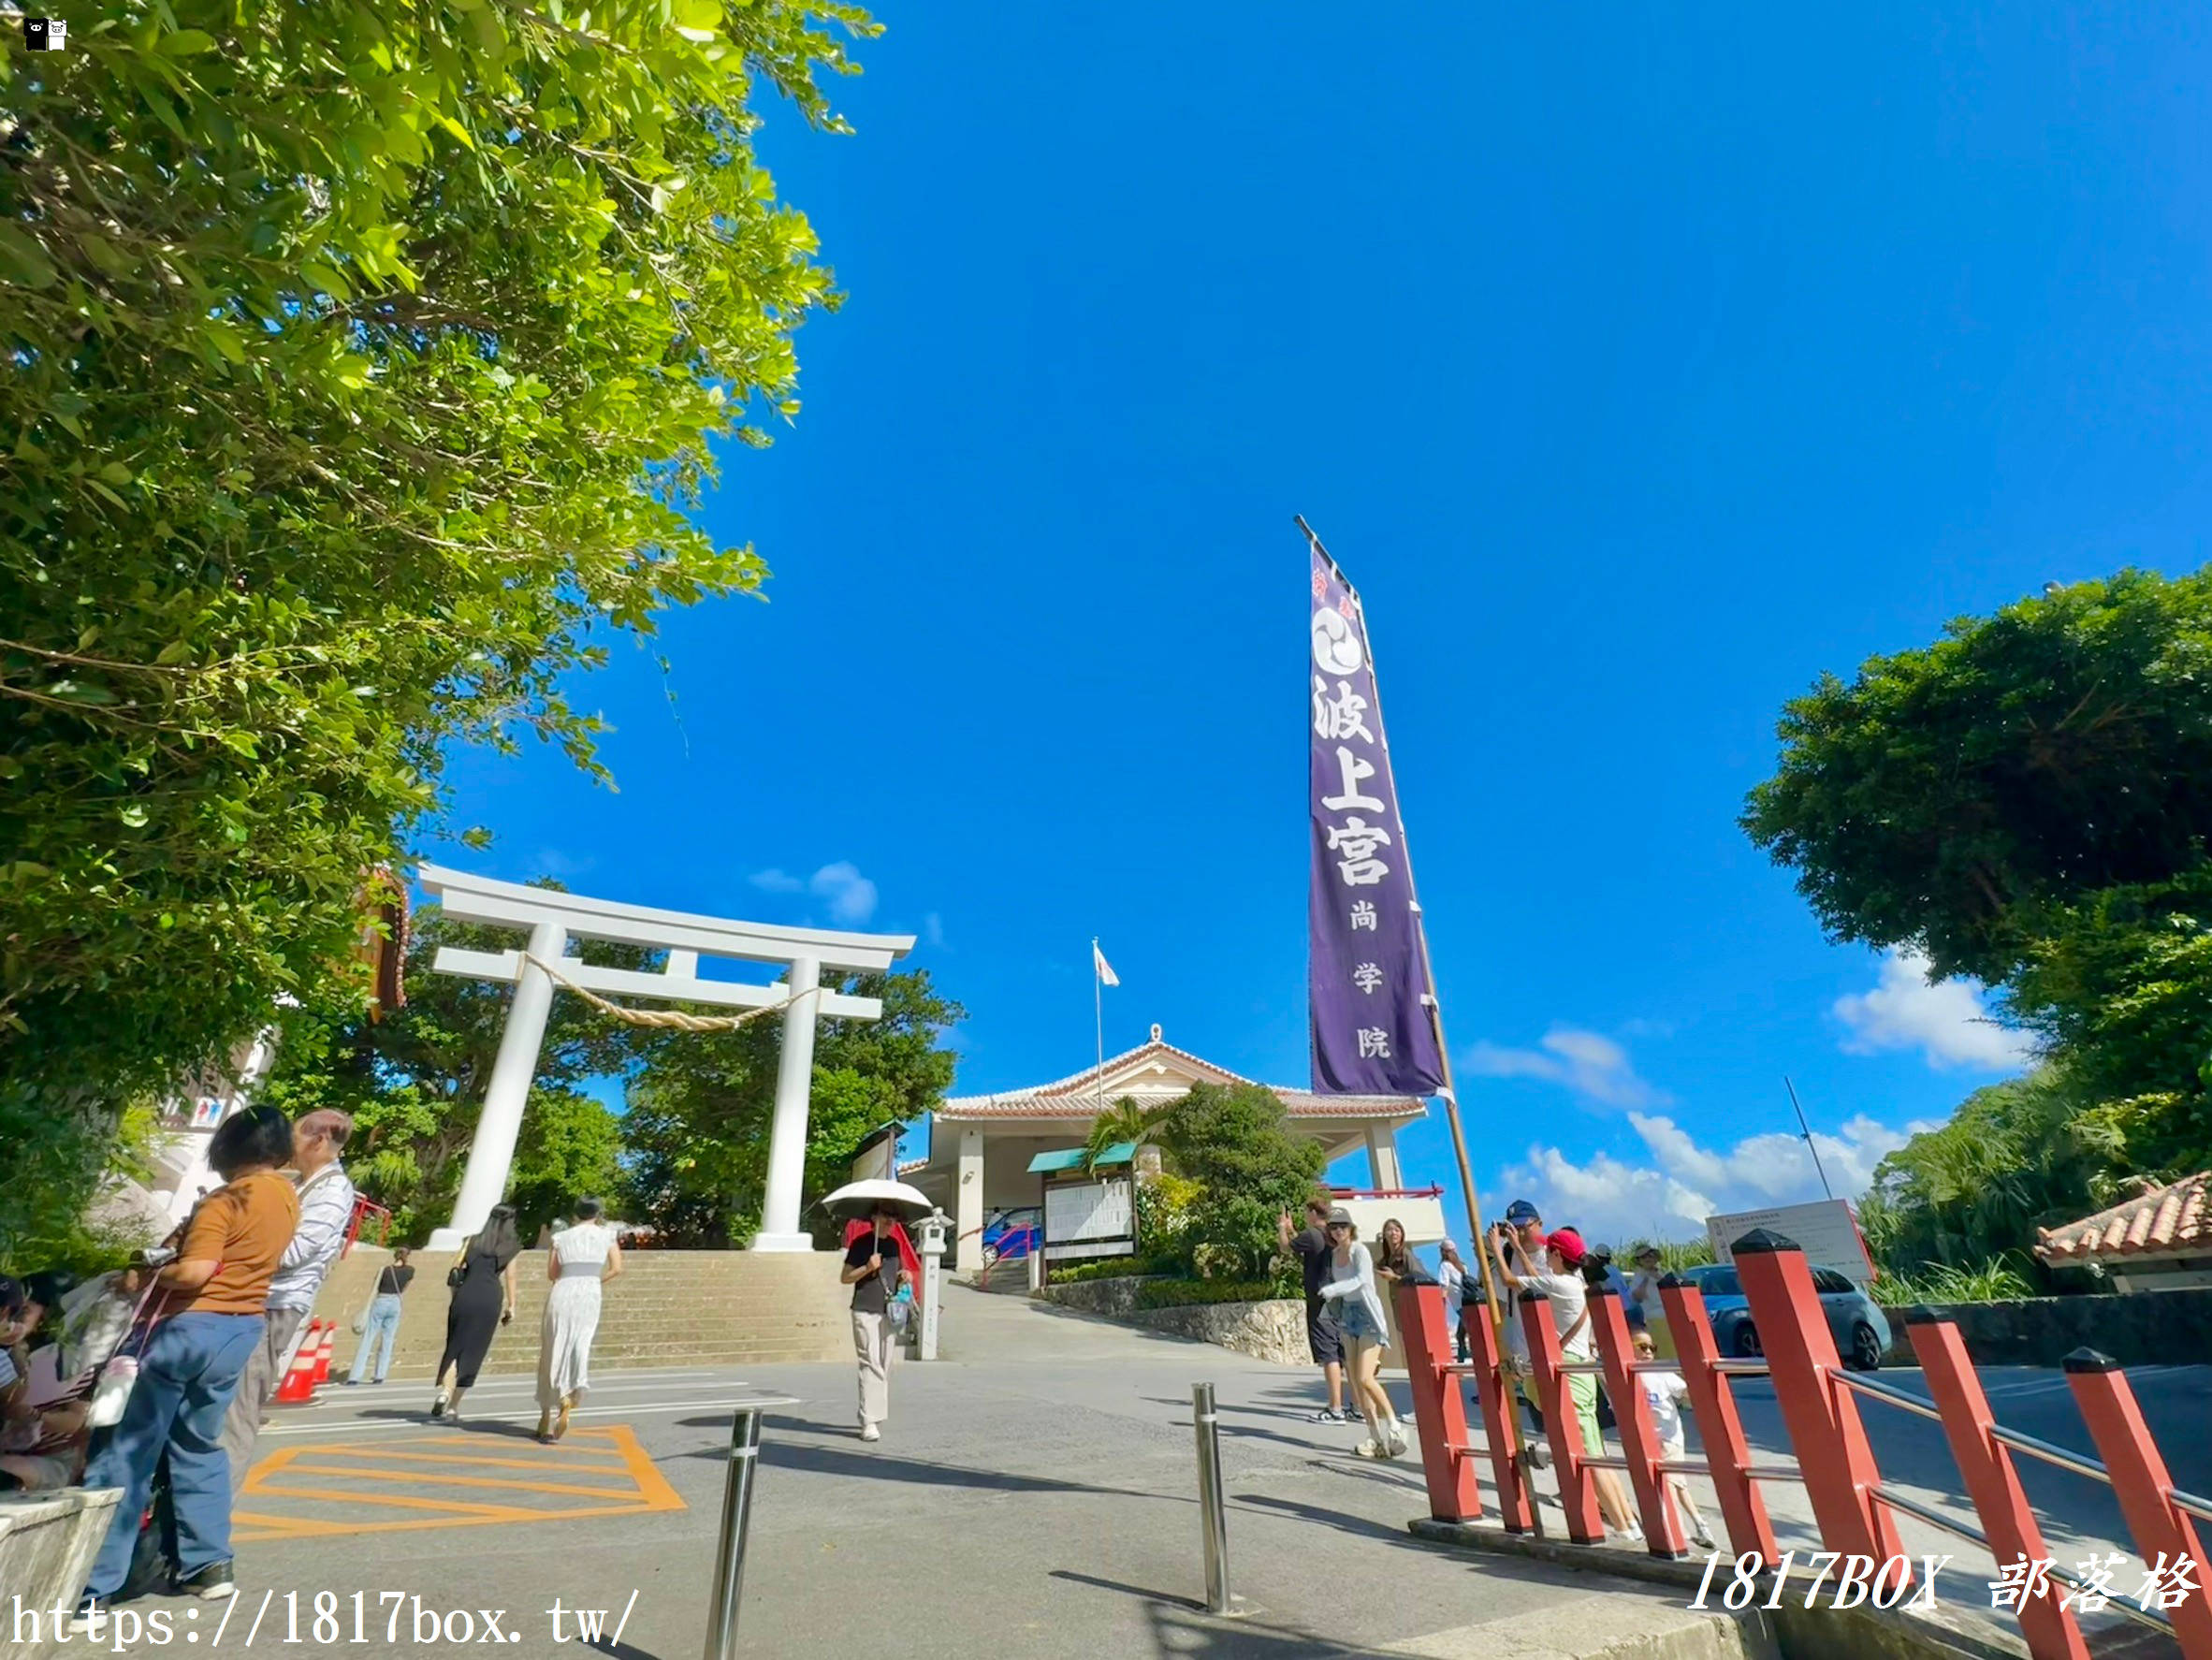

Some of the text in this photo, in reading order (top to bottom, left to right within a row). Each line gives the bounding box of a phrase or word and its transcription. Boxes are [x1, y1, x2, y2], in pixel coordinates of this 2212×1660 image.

[1312, 674, 1392, 888] 波上宮
[1348, 900, 1392, 1060] 尚学院
